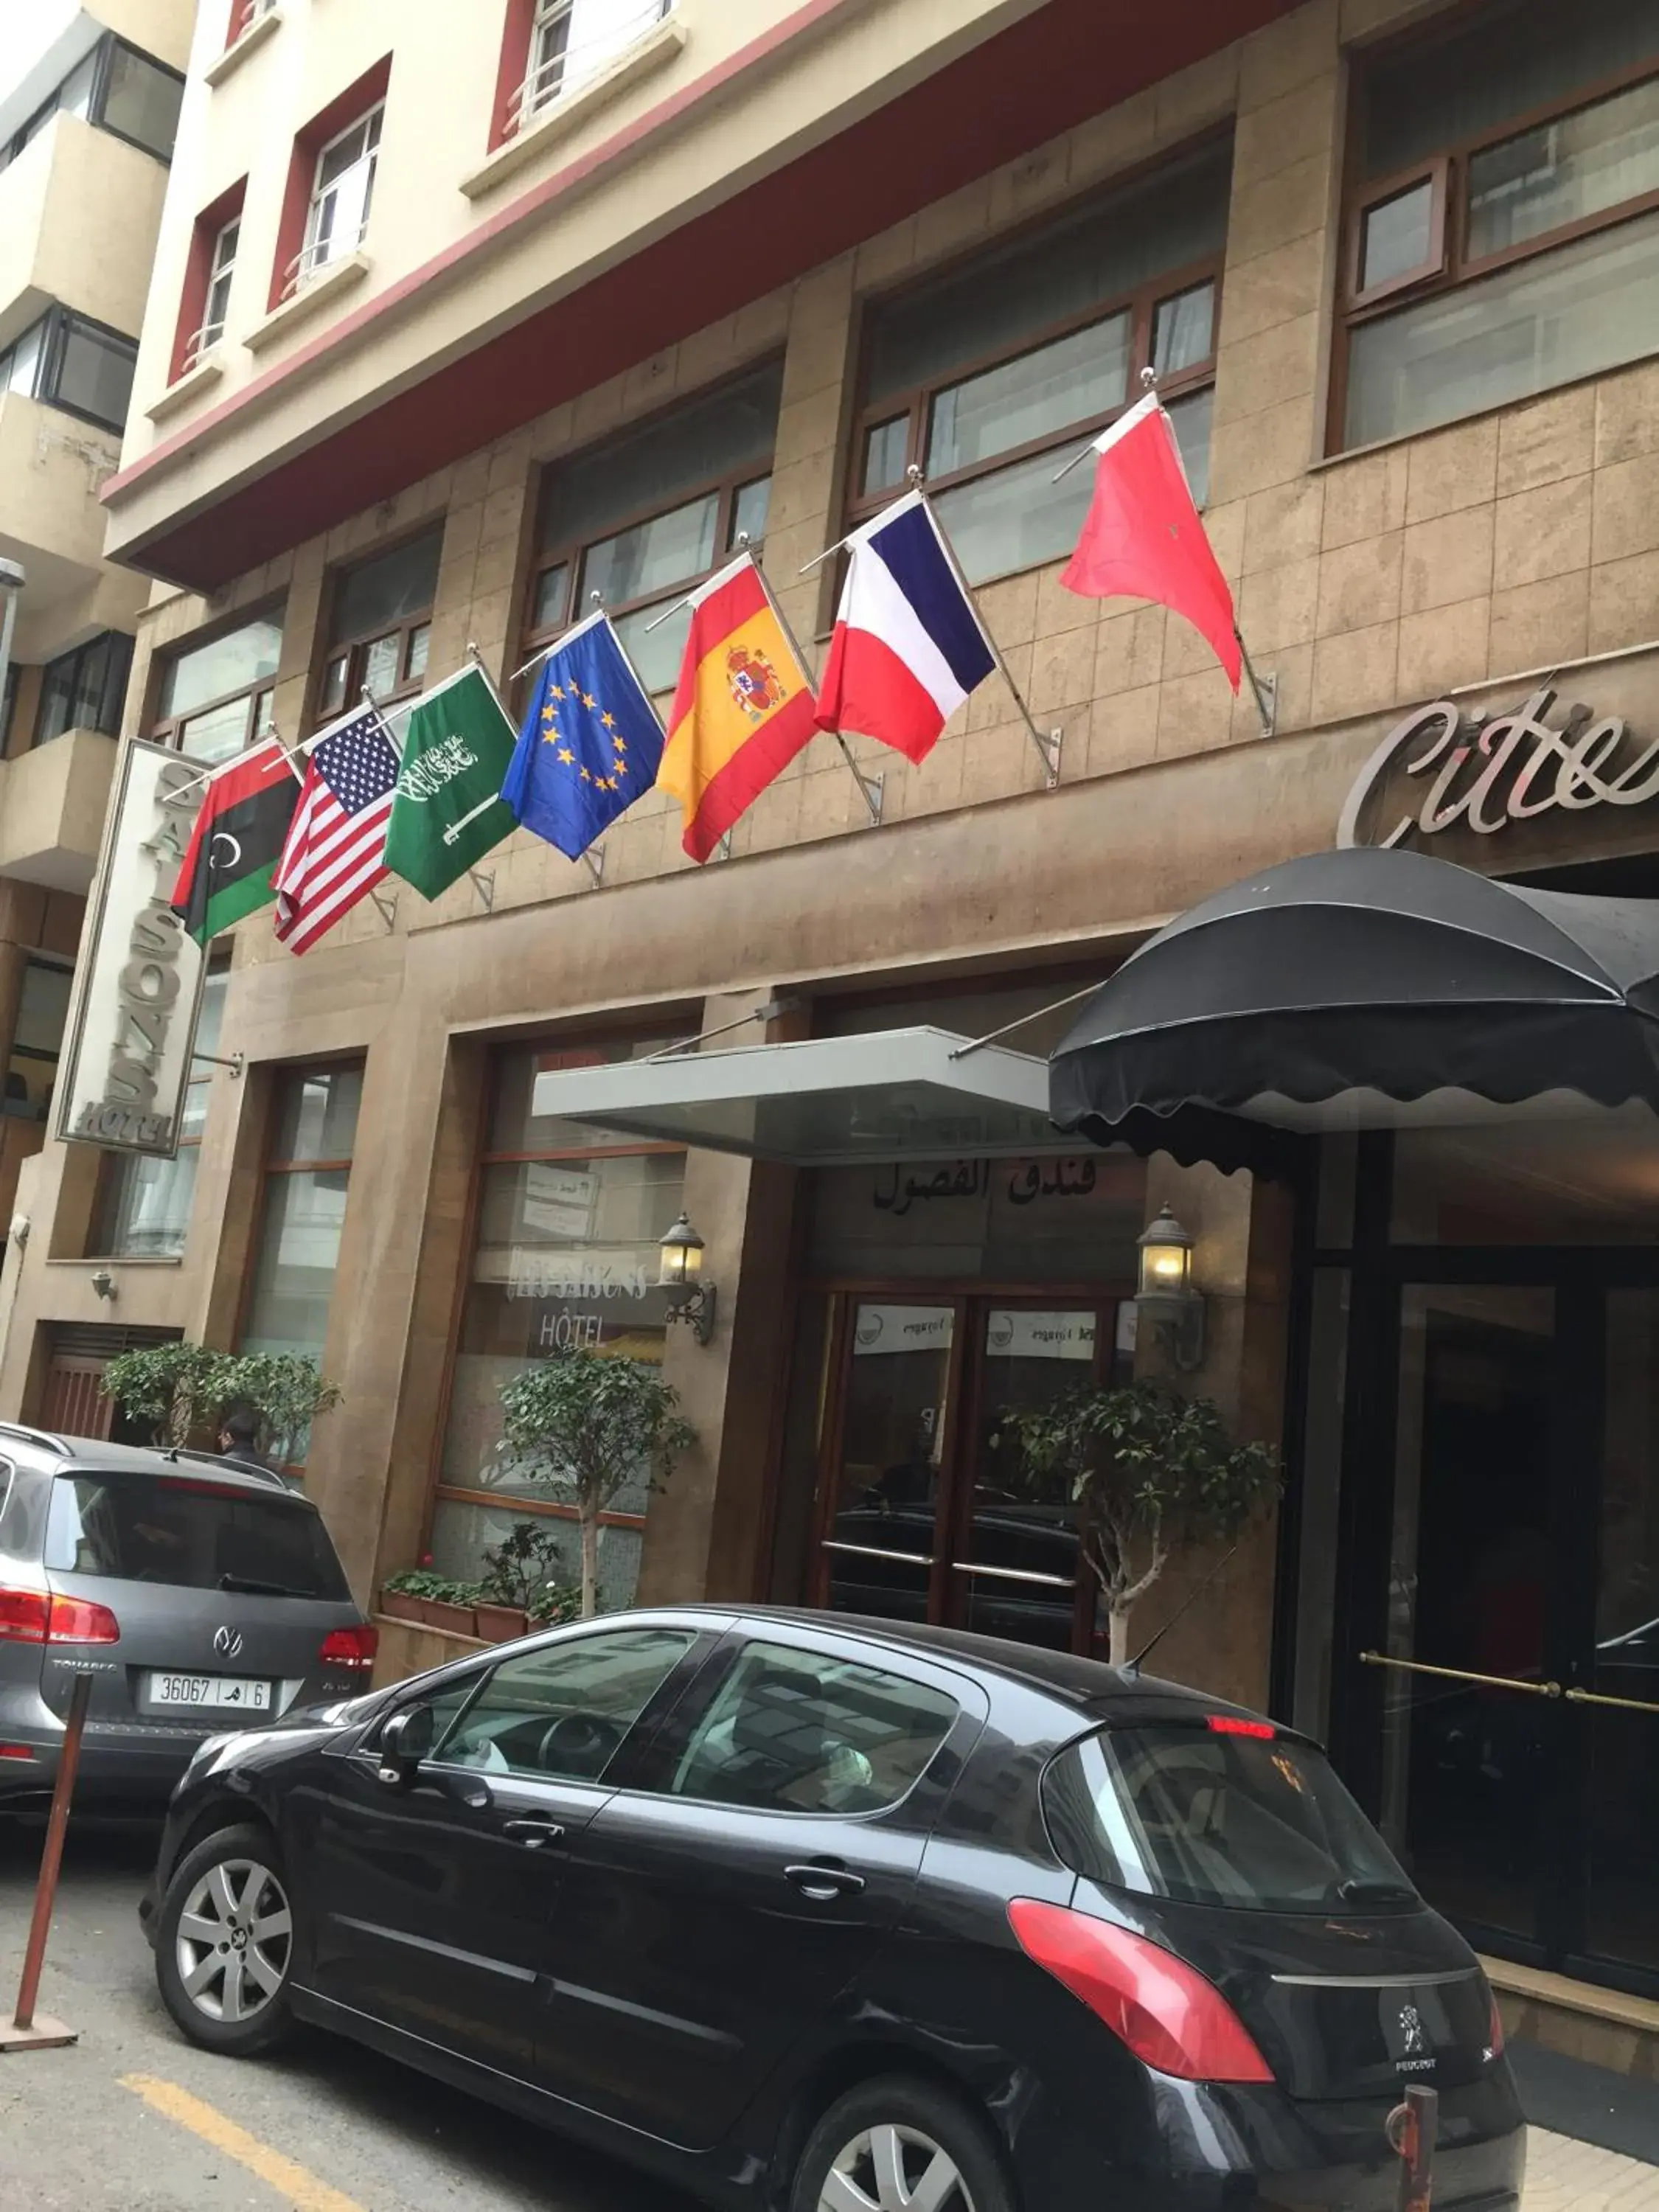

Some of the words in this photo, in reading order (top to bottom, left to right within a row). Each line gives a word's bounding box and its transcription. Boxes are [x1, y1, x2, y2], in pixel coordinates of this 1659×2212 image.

[873, 1158, 990, 1216] الفصول
[1007, 1156, 1096, 1205] فندق
[540, 1306, 606, 1349] HÔTEL
[161, 1677, 210, 1703] 36067
[254, 1683, 263, 1706] 6
